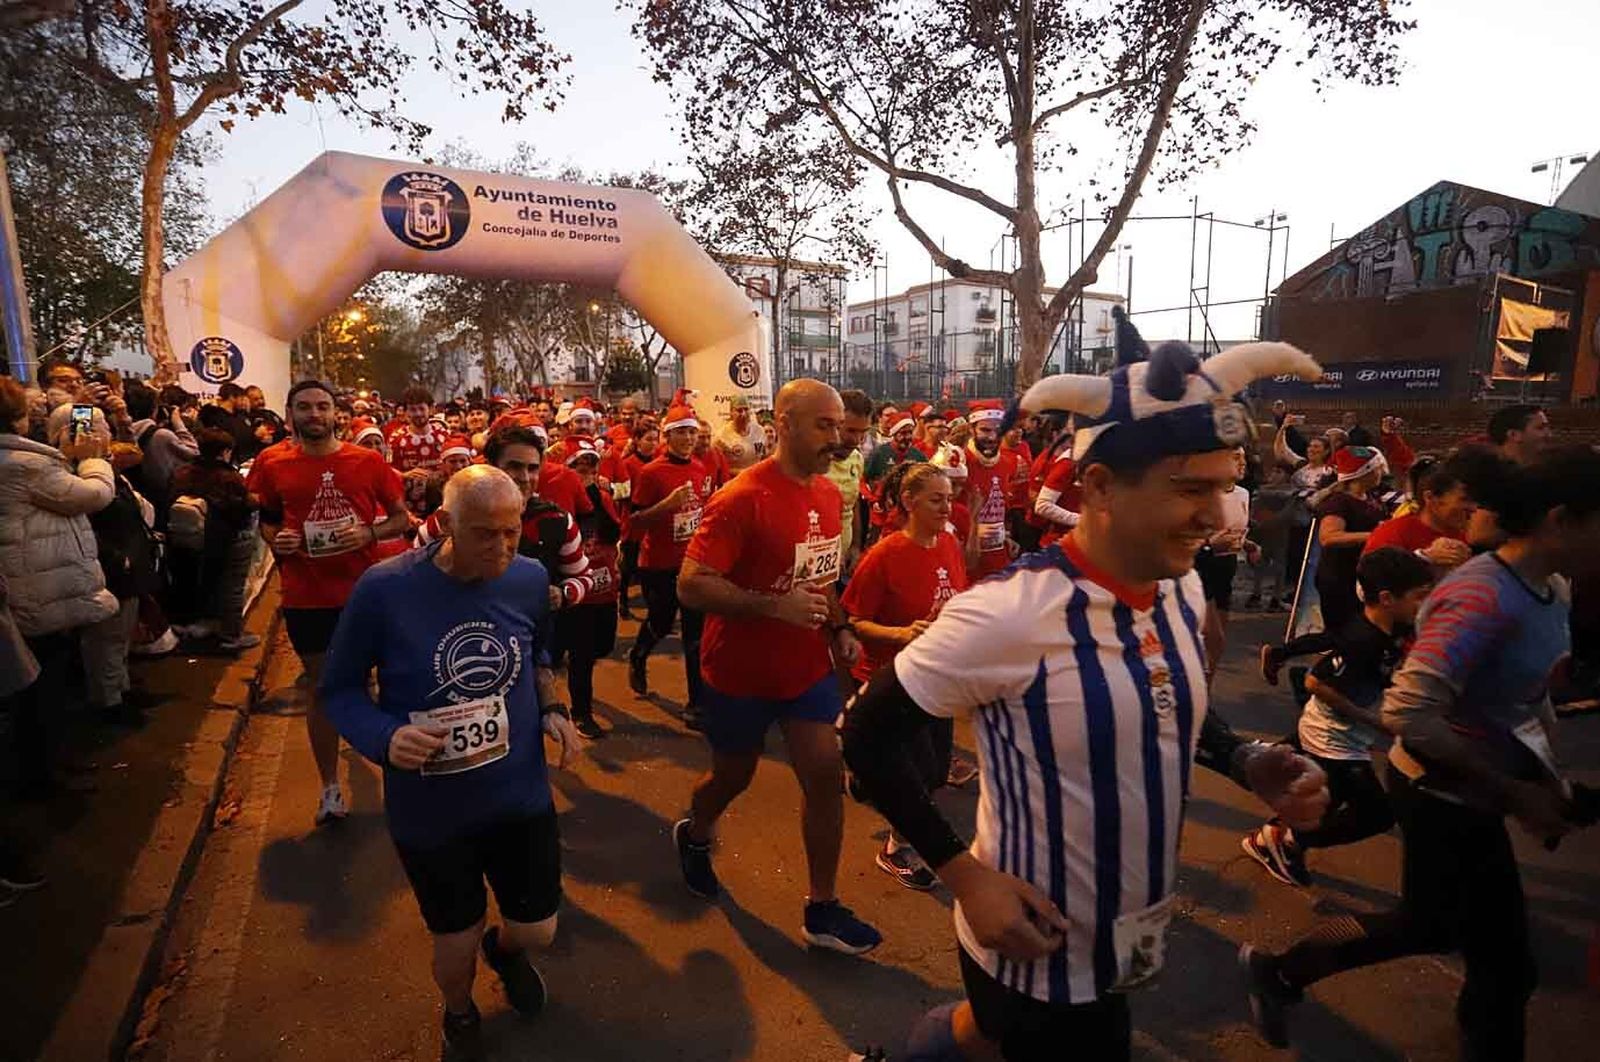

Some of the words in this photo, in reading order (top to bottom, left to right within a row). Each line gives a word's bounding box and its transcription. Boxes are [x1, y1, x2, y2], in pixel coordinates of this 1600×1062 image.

[473, 185, 617, 212] Ayuntamiento
[517, 206, 543, 222] de
[550, 208, 618, 229] Huelva
[551, 228, 565, 239] de
[569, 229, 621, 244] Deportes
[1380, 368, 1441, 380] HYUNDAI
[815, 551, 838, 575] 282
[433, 653, 444, 685] CLUB
[452, 719, 499, 752] 539
